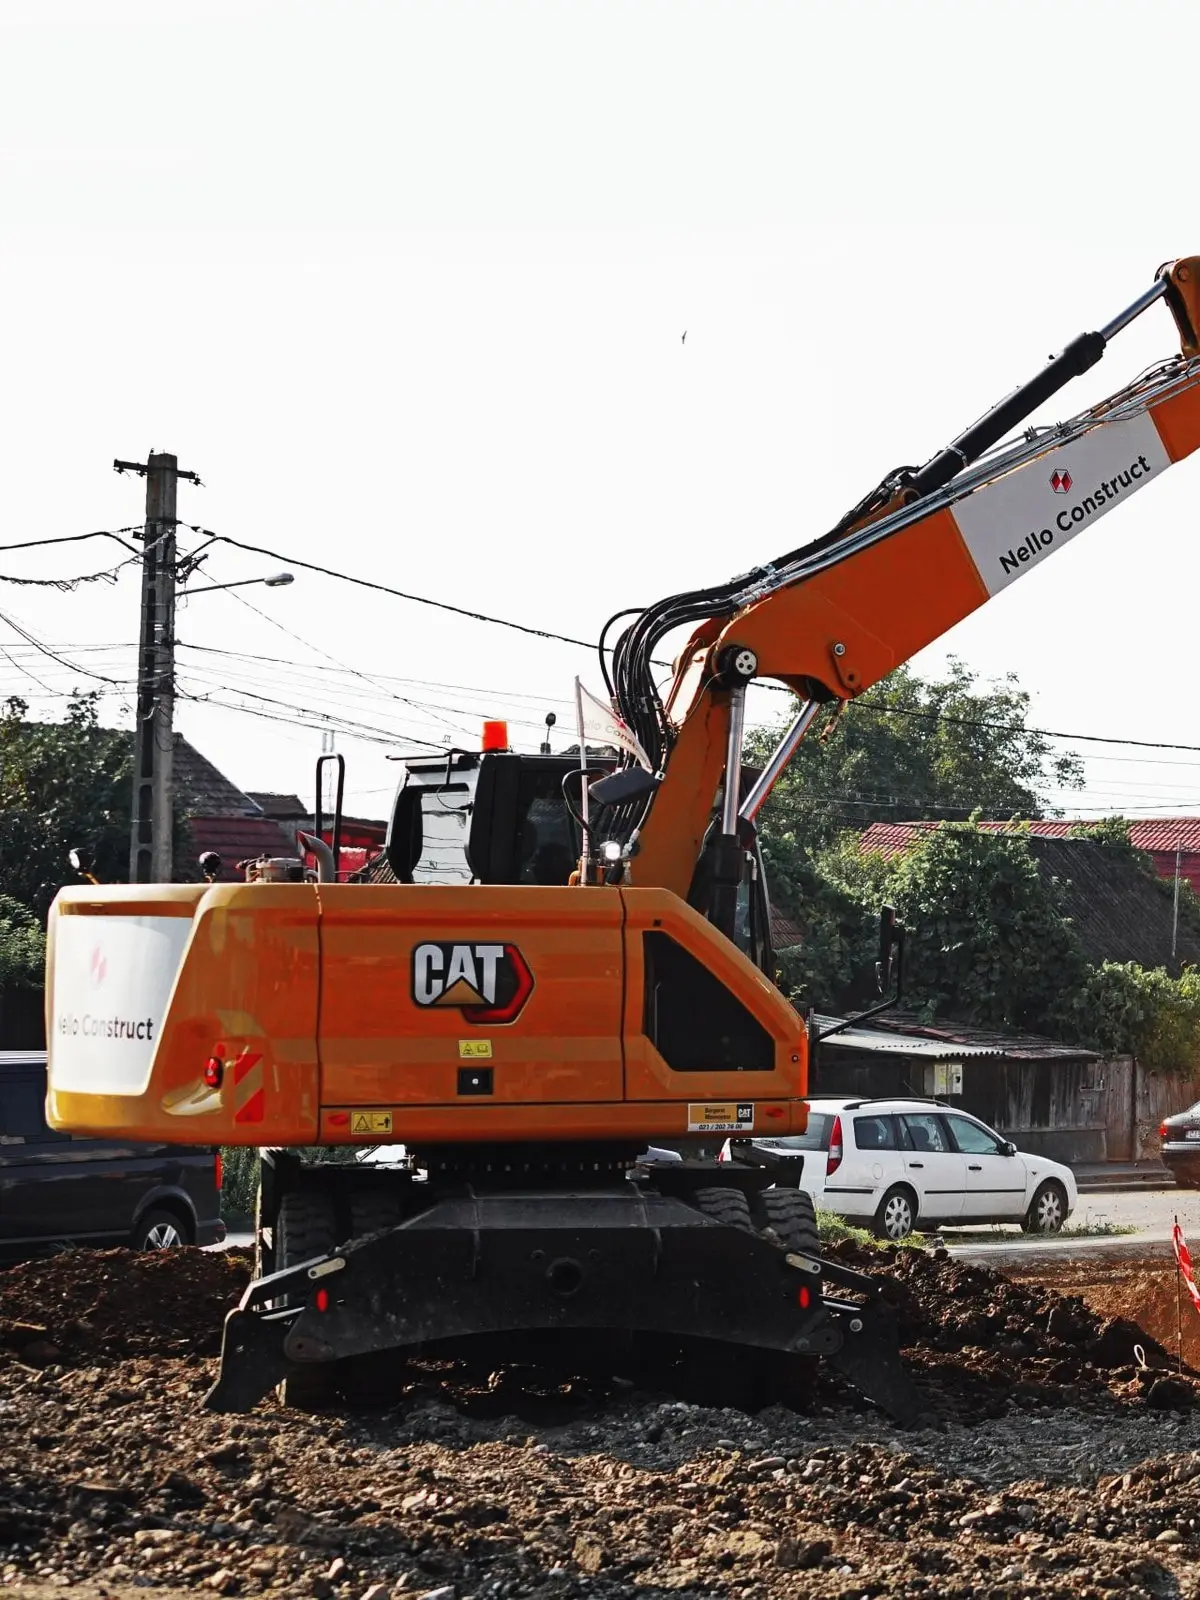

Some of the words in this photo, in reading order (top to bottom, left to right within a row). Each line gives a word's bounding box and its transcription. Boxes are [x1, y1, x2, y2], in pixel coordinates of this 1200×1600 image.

[999, 529, 1054, 575] Nello
[1056, 454, 1151, 532] Construct
[414, 944, 504, 1005] CAT
[83, 1014, 154, 1041] Construct
[738, 1108, 752, 1118] CAT
